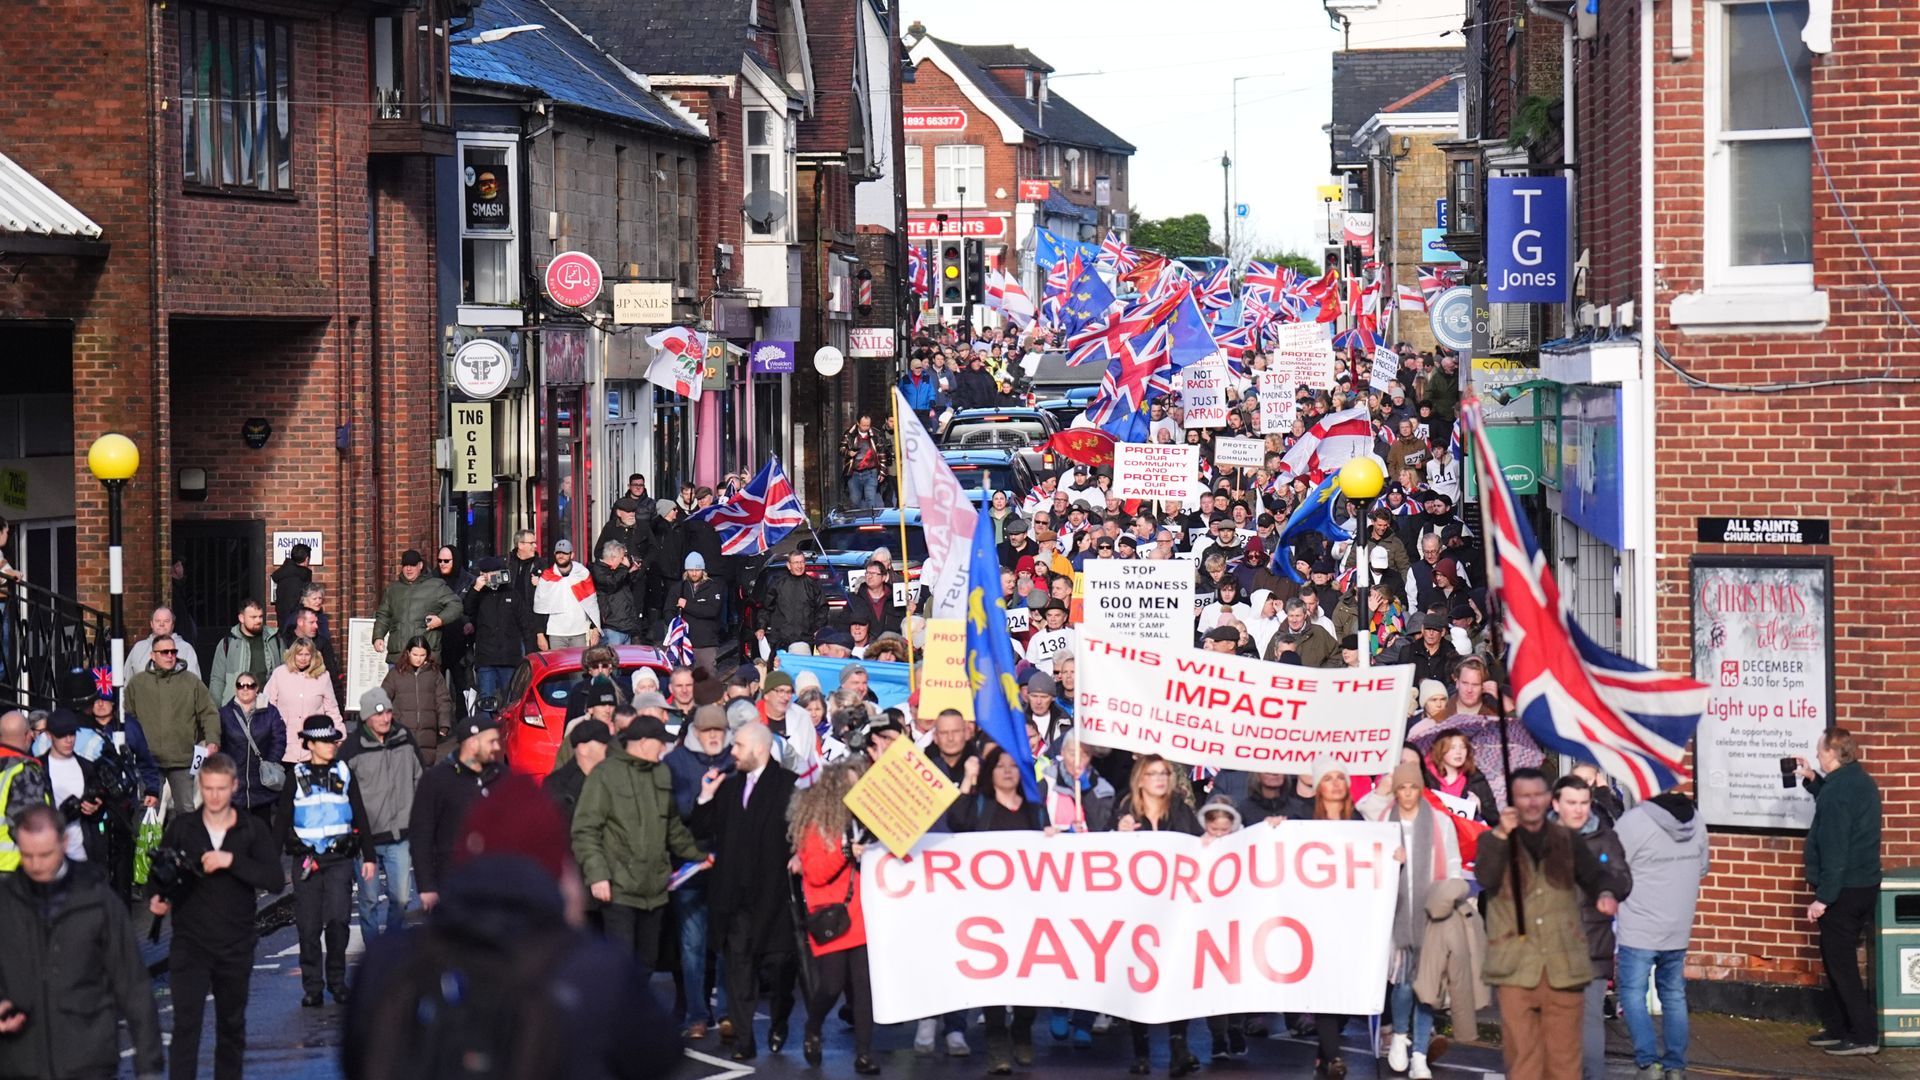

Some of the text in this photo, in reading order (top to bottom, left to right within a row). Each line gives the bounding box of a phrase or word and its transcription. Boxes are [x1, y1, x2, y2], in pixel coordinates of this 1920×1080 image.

[903, 117, 924, 126] 1892
[472, 202, 504, 217] SMASH
[1512, 189, 1543, 225] T
[928, 220, 985, 233] AGENTS
[1511, 229, 1543, 266] G
[1498, 268, 1557, 291] Jones
[616, 298, 669, 309] JP NAILS
[850, 336, 894, 350] NAILS
[1281, 351, 1328, 359] PROTECT
[1193, 370, 1213, 380] NOT
[1264, 373, 1291, 385] STOP
[1187, 378, 1221, 389] RACIST
[1191, 395, 1219, 407] JUST
[1261, 391, 1293, 399] MADNESS
[1186, 407, 1224, 420] AFRAID
[1266, 401, 1293, 414] STOP
[458, 409, 484, 425] TN6
[1125, 446, 1189, 456] PROTECT
[1222, 442, 1258, 450] PROTECT
[466, 430, 477, 485] CAFE
[1123, 460, 1188, 468] COMMUNITY
[1123, 473, 1188, 483] PROTECT
[1434, 471, 1454, 484] 211
[1122, 487, 1187, 497] FAMILIES
[1726, 519, 1799, 533] ALL SAINTS
[277, 537, 319, 548] ASHDOWN
[1723, 532, 1803, 543] CHURCH CENTRE
[1122, 565, 1156, 575] STOP
[1090, 580, 1121, 590] THIS
[1125, 580, 1189, 590] MADNESS
[1099, 596, 1179, 609] 600 MEN
[1702, 575, 1806, 619] CHRISTMAS
[1104, 611, 1171, 619] IN ONE SMALL
[1007, 615, 1027, 629] 224
[933, 633, 967, 642] PROT
[1039, 636, 1067, 654] 138
[946, 656, 966, 666] OU
[1084, 637, 1396, 693] THIS WILL BE THE
[1722, 660, 1804, 674] SAT DECEMBER
[925, 678, 971, 689] CHILDR
[1721, 671, 1805, 691] 06 4.30 for 5pm
[1165, 678, 1307, 721] IMPACT
[1706, 696, 1817, 722] Light up a Life
[1107, 698, 1143, 718] 600
[1150, 706, 1225, 734] ILLEGAL
[1231, 723, 1391, 744] UNDOCUMENTED
[1081, 715, 1130, 737] MEN
[1139, 727, 1162, 743] IN
[1171, 734, 1225, 756] OUR
[1730, 727, 1793, 738] An opportunity to
[1715, 739, 1809, 749] celebrate the lives of loved
[1728, 751, 1758, 759] ones we
[904, 750, 943, 790] STOP
[874, 841, 1384, 903] CROWBOROUGH
[955, 915, 1315, 994] SAYS NO
